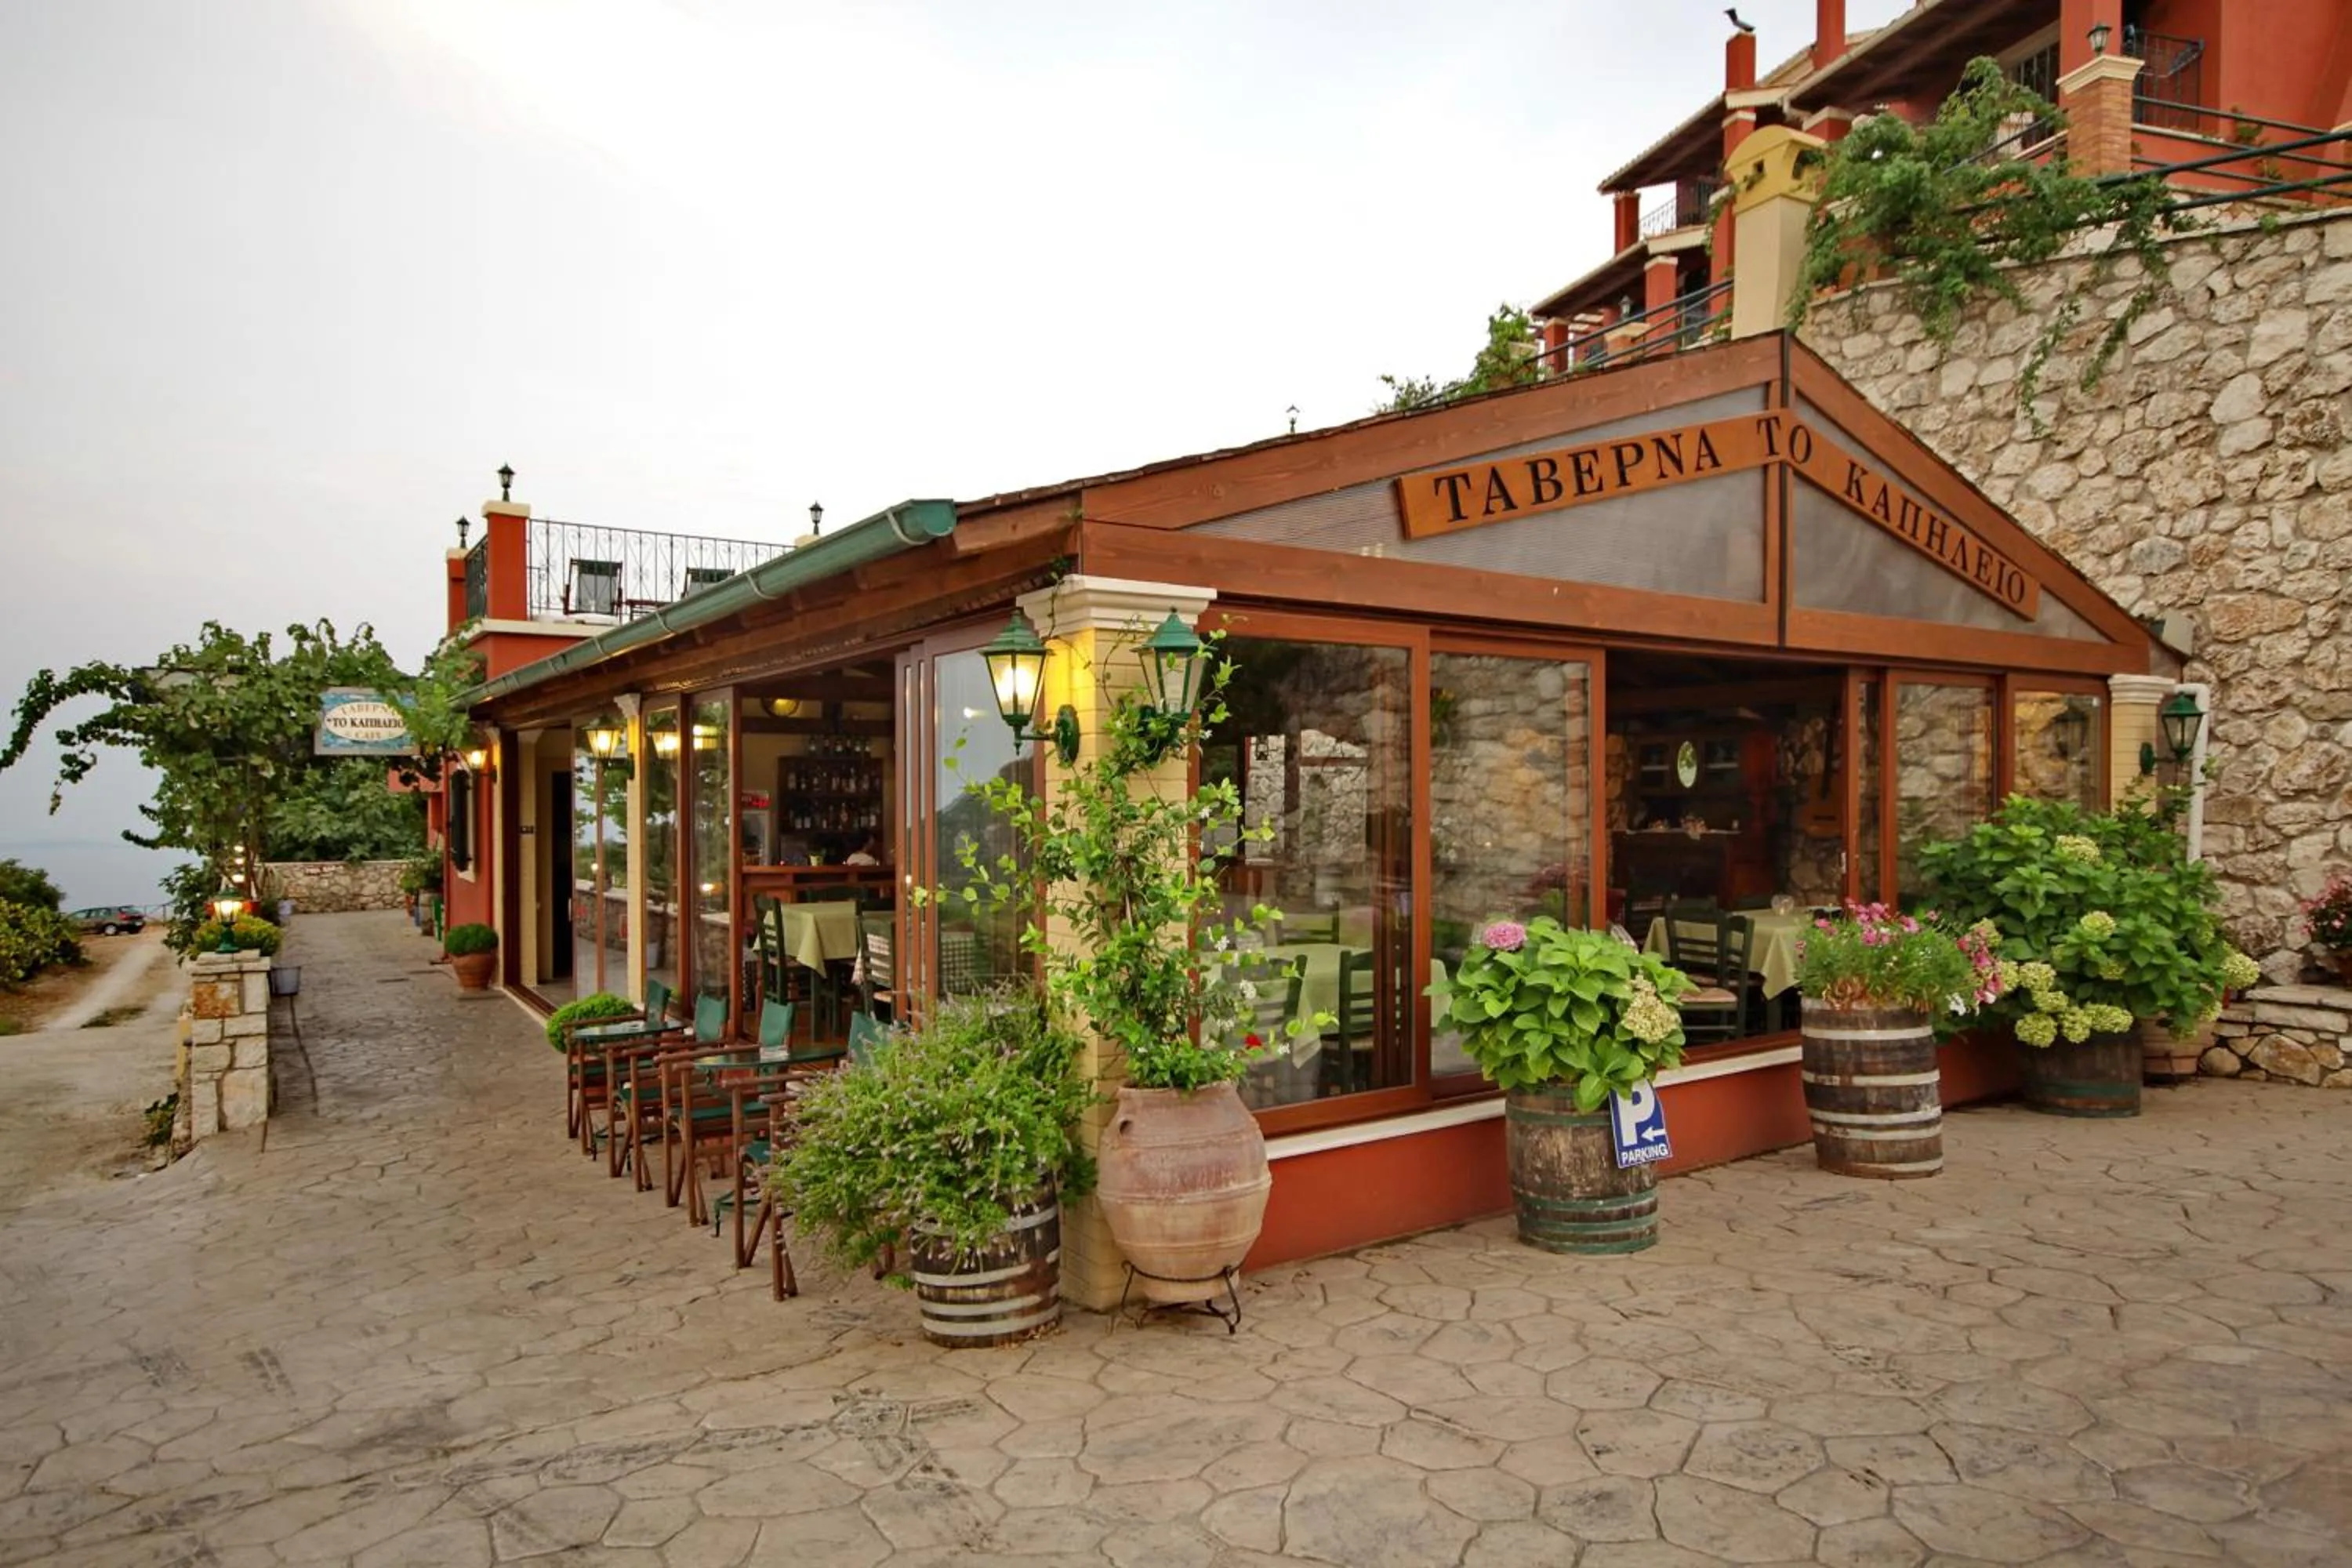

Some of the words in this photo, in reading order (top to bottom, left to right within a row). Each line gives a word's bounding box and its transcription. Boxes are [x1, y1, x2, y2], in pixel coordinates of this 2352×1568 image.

[1434, 427, 1722, 523] ΤΑΒΕΡΝΑ
[1756, 416, 1812, 464] ΤΟ
[1844, 459, 2026, 604] ΚΑΠΗΛΕΙΟ
[1617, 1077, 1655, 1146] P
[1621, 1143, 1668, 1163] PARKING
